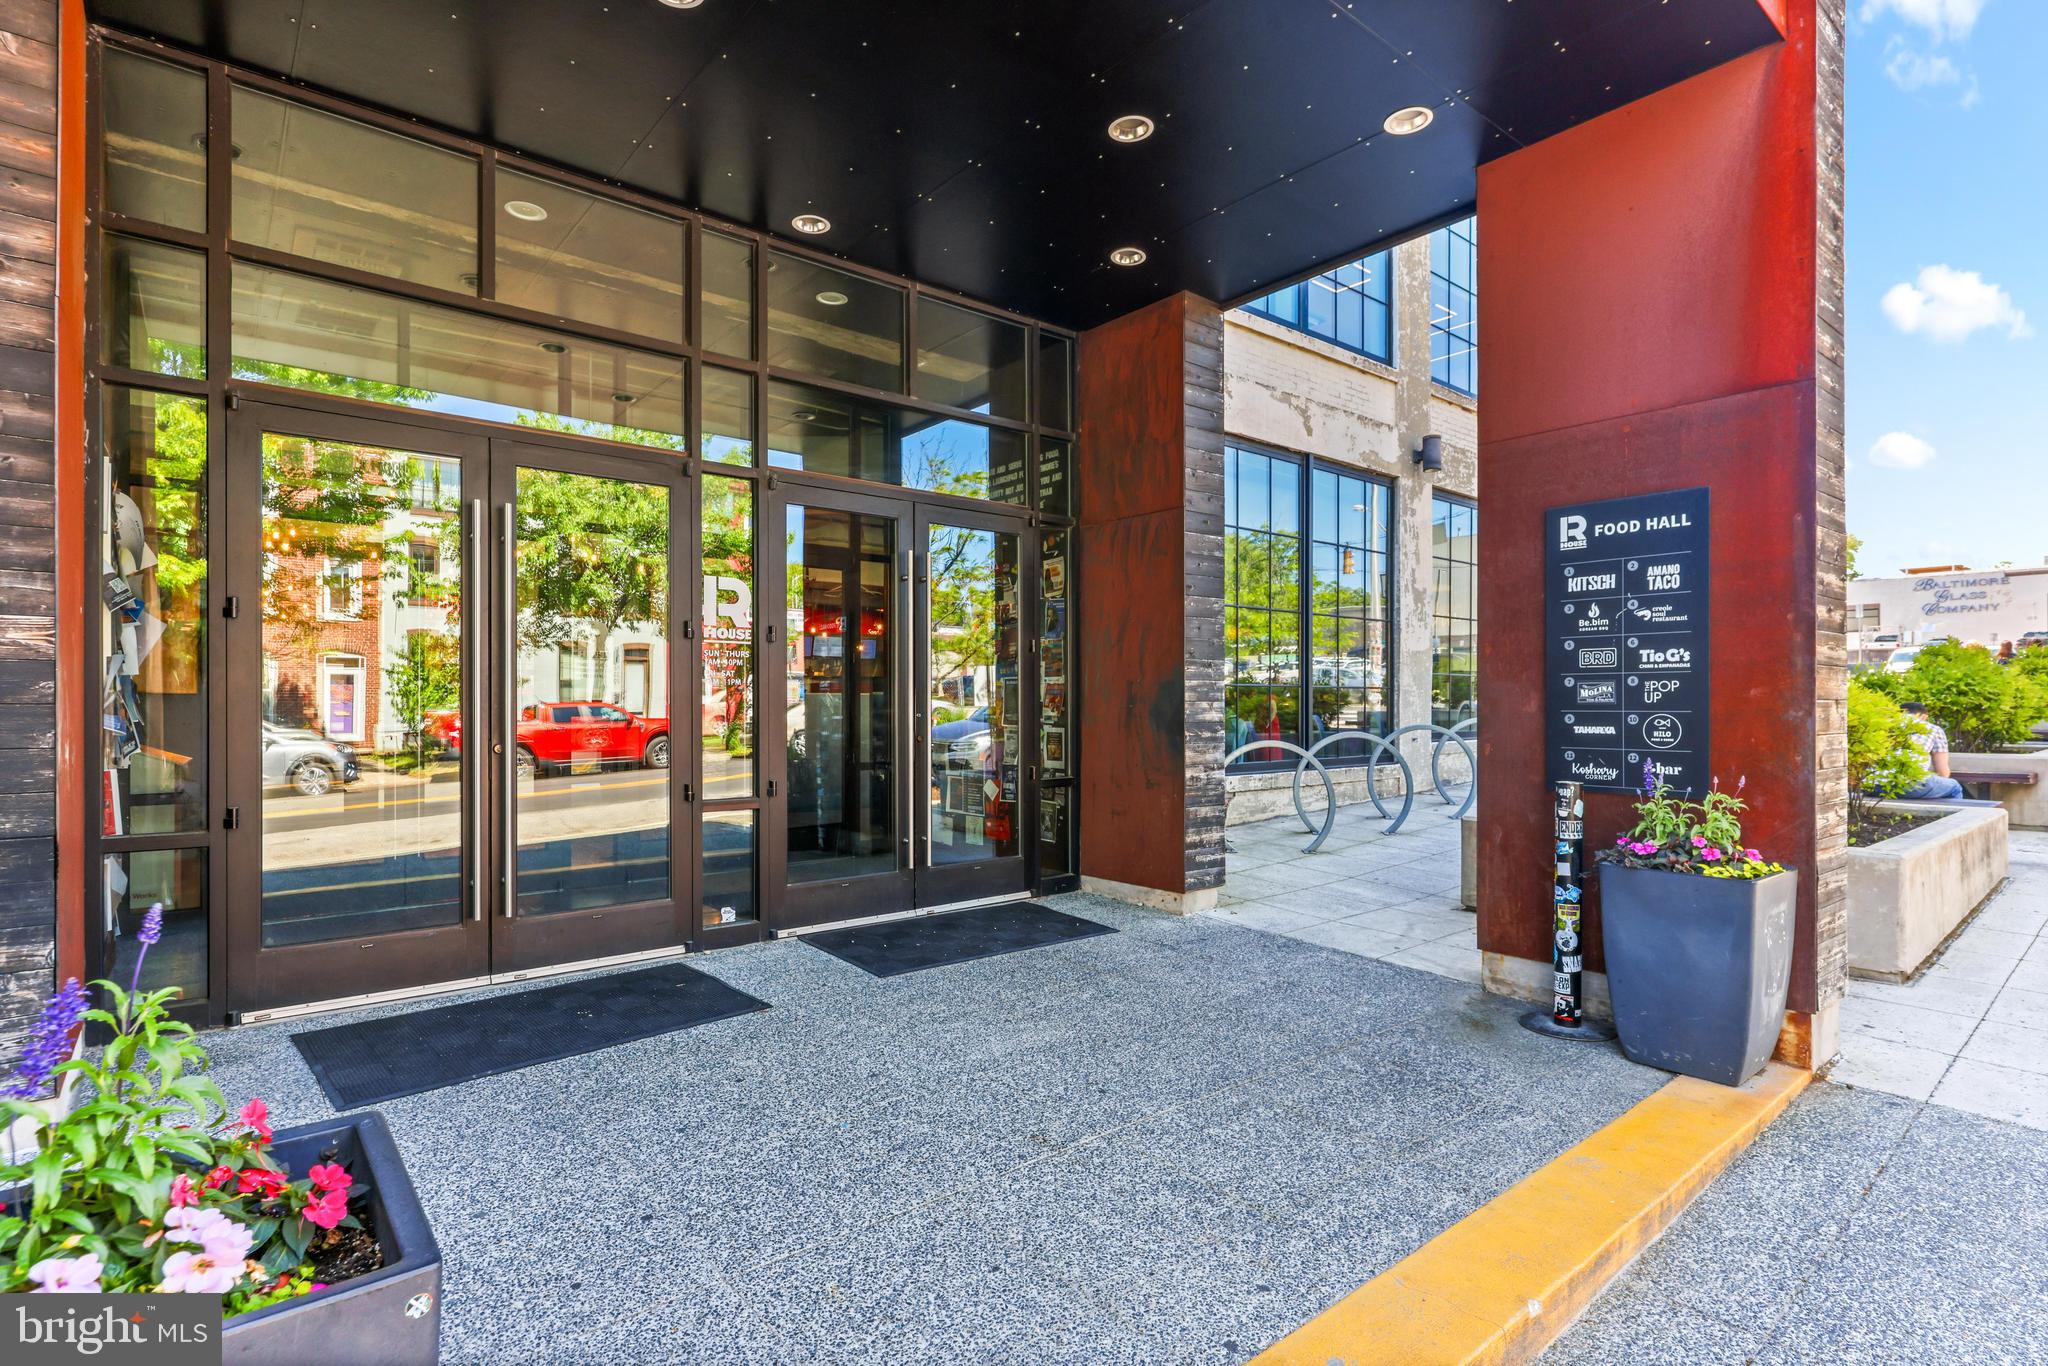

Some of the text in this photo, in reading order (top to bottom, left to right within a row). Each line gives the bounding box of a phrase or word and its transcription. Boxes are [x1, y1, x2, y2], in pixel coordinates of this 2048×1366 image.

[1560, 515, 1587, 542] R
[1595, 513, 1692, 537] FOOD HALL
[1560, 539, 1588, 549] HOUSE
[1647, 563, 1681, 577] AMANO
[1568, 574, 1617, 592] KITSCH
[1647, 574, 1681, 591] TACO
[1913, 576, 2010, 592] BALTIMORE
[704, 575, 752, 628] R
[1934, 590, 1987, 603] GLASS
[1922, 602, 2001, 616] COMPANY
[704, 628, 752, 640] HOUSE
[704, 649, 720, 657] SUN
[725, 650, 750, 658] THURS
[1581, 651, 1615, 665] BRD
[1639, 649, 1664, 662] Tio
[1651, 680, 1680, 692] POP
[1644, 692, 1662, 703] UP
